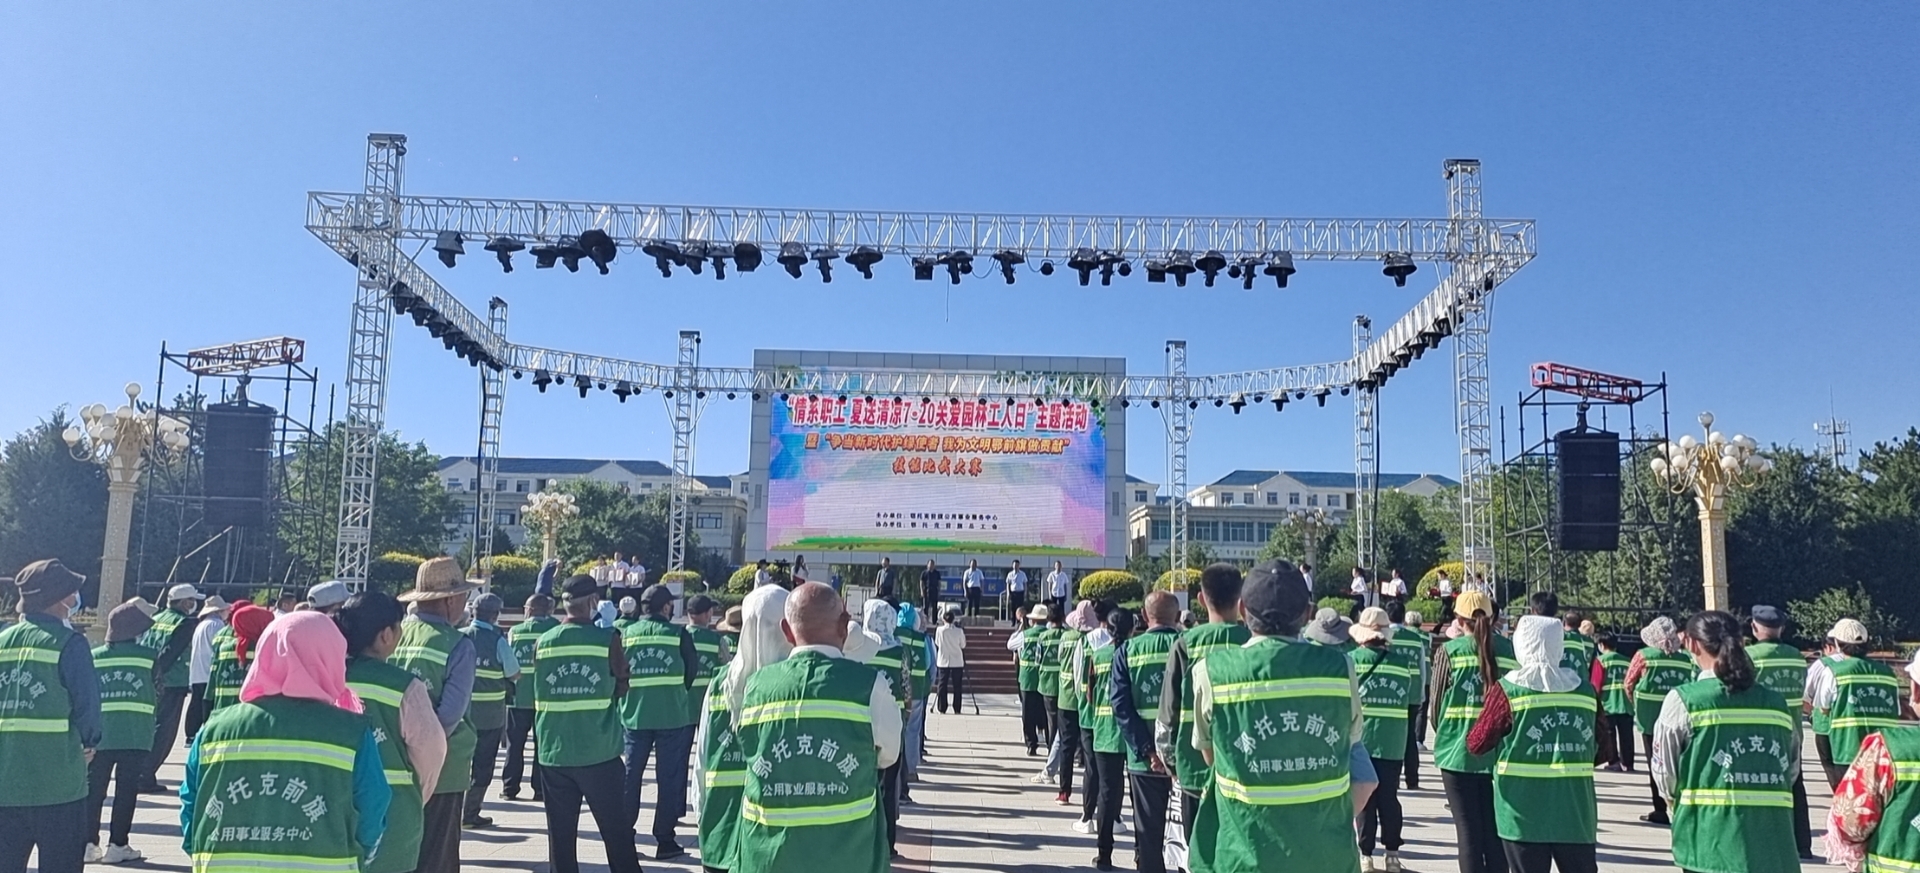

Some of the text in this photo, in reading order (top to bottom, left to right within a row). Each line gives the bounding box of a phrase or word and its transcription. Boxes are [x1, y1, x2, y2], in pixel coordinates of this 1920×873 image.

[892, 456, 983, 476] 技能比武大赛
[546, 661, 602, 686] 鄂托克前旗
[752, 733, 859, 780] 鄂托克前旗
[1248, 755, 1339, 774] 公用事业服务中心
[205, 771, 328, 823] 鄂托克前旗
[762, 781, 849, 797] 公用事业服务中心
[210, 826, 313, 842] 公用事业服务中心
